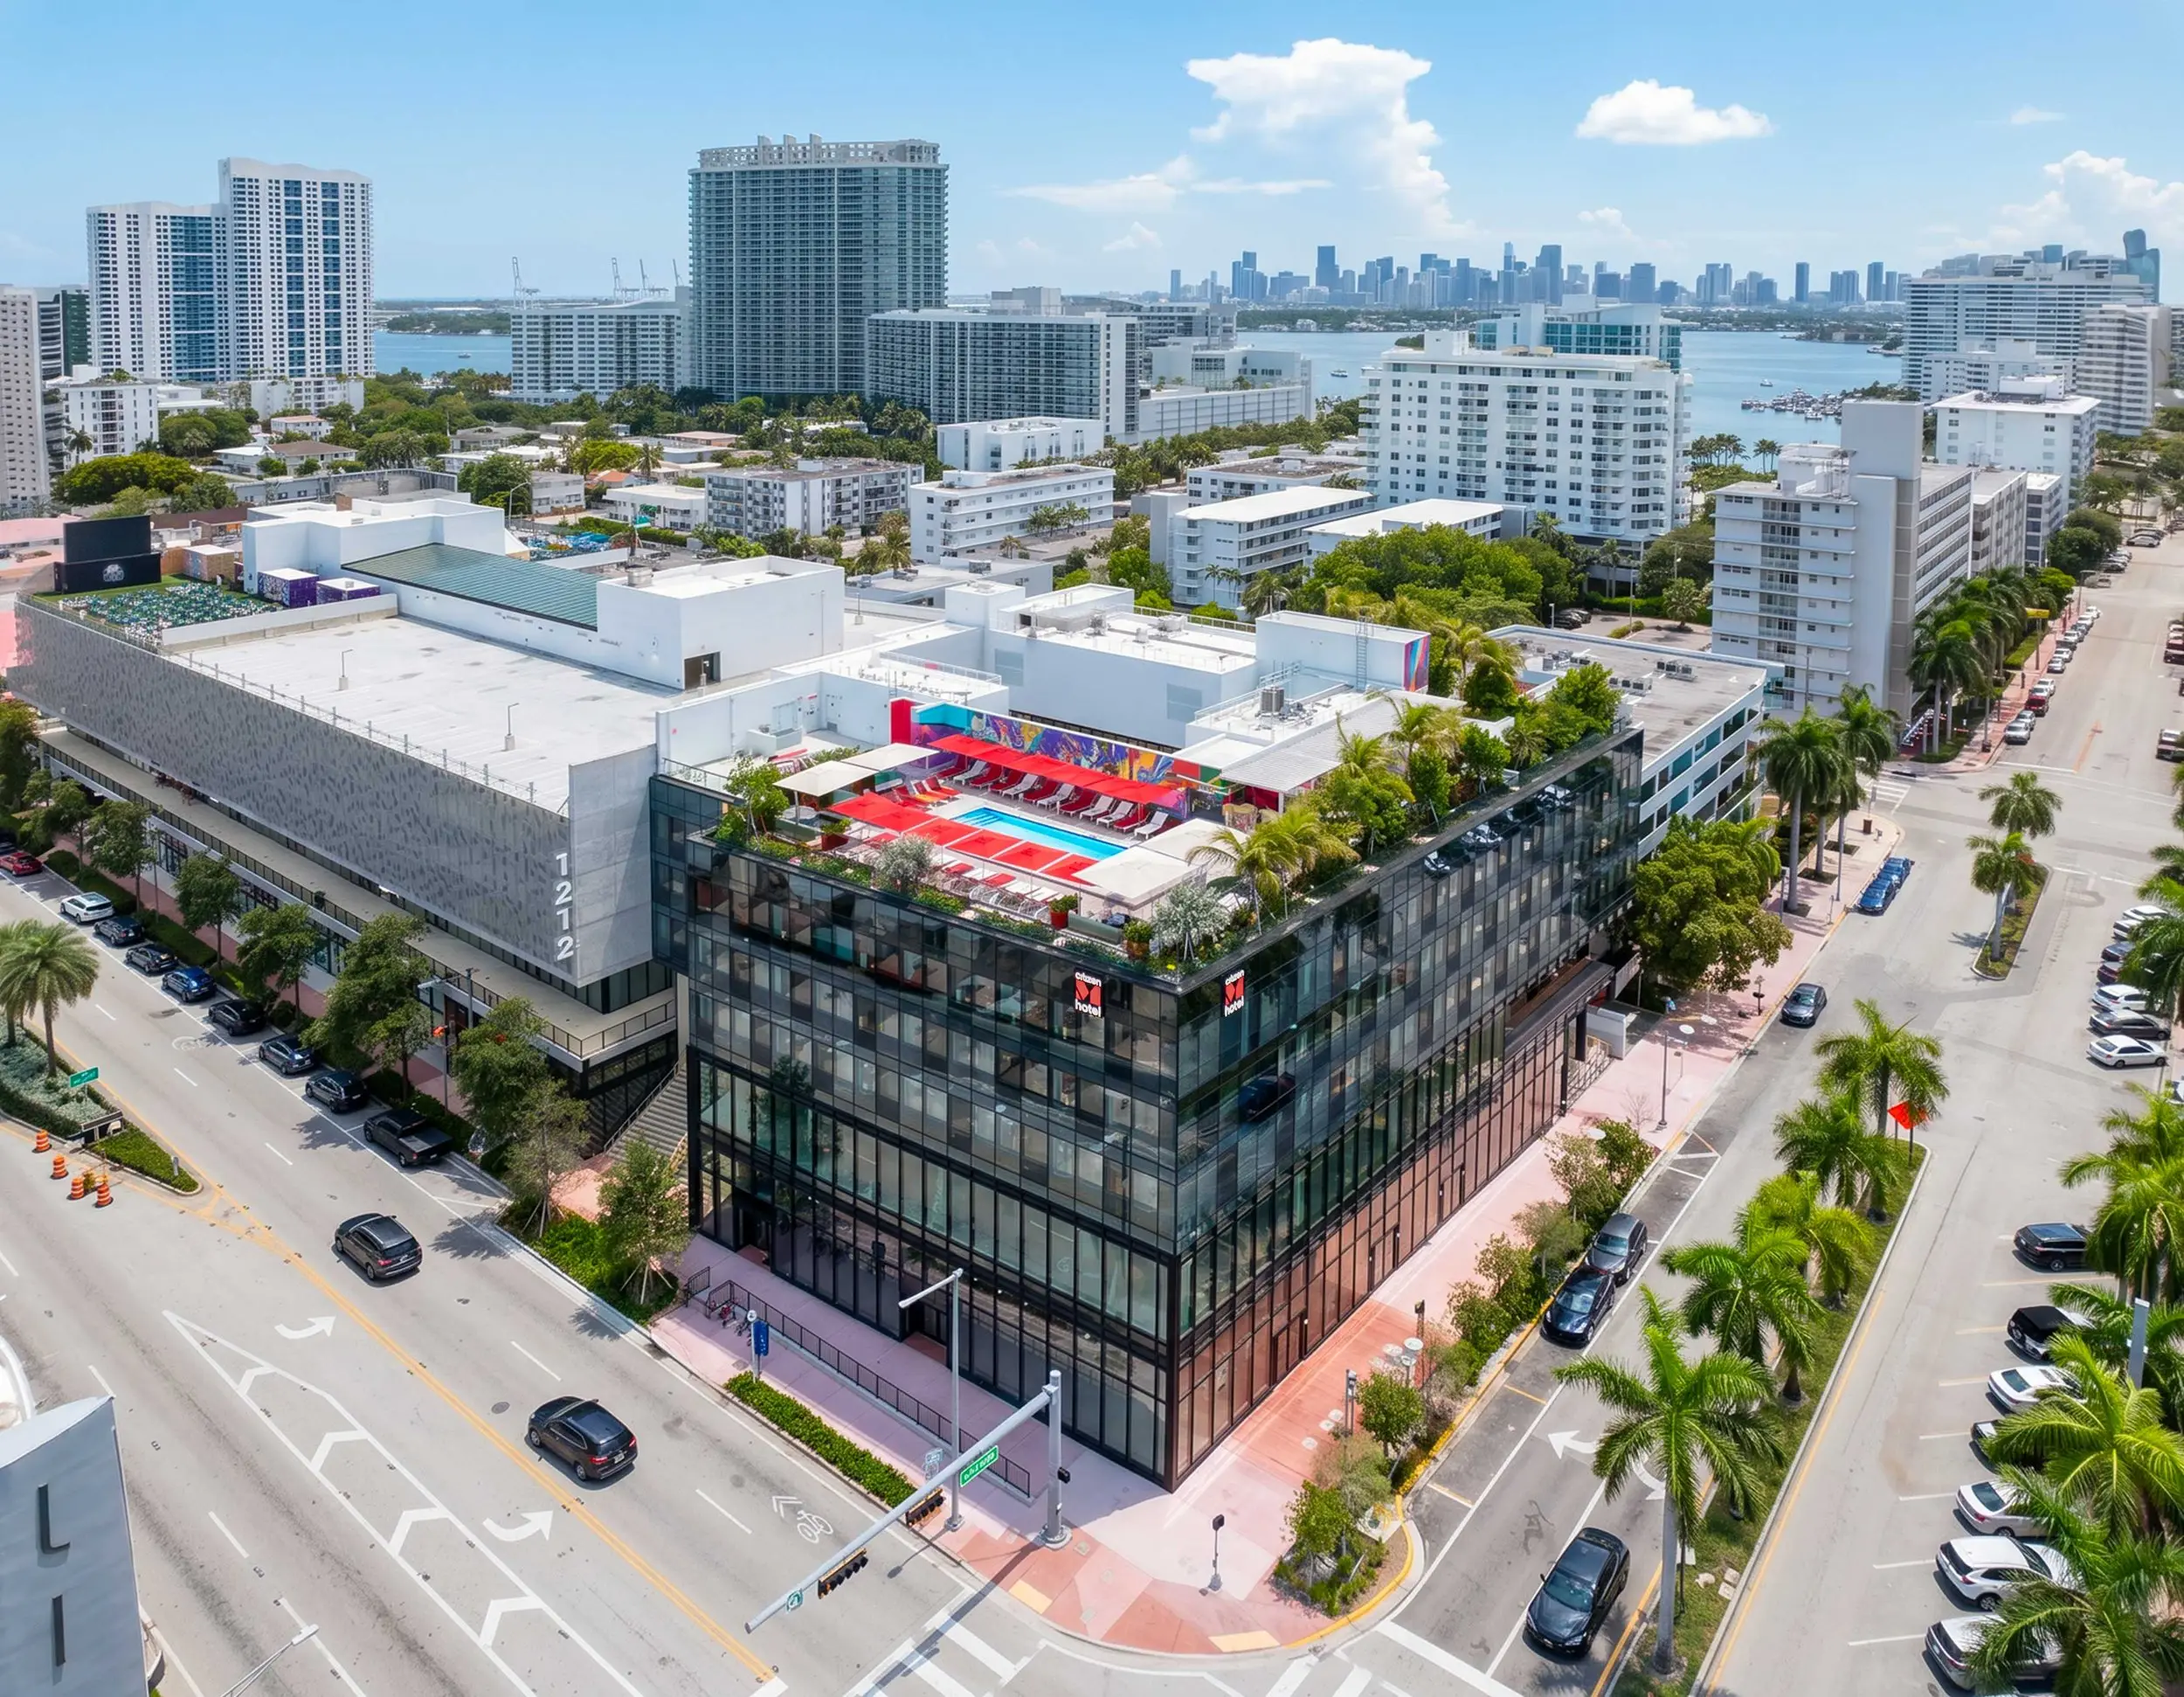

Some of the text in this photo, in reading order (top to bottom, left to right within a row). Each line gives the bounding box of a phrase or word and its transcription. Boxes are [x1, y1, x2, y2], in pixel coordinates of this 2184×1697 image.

[555, 852, 574, 961] 1212
[1075, 999, 1102, 1017] hotel
[1225, 995, 1245, 1017] hotel
